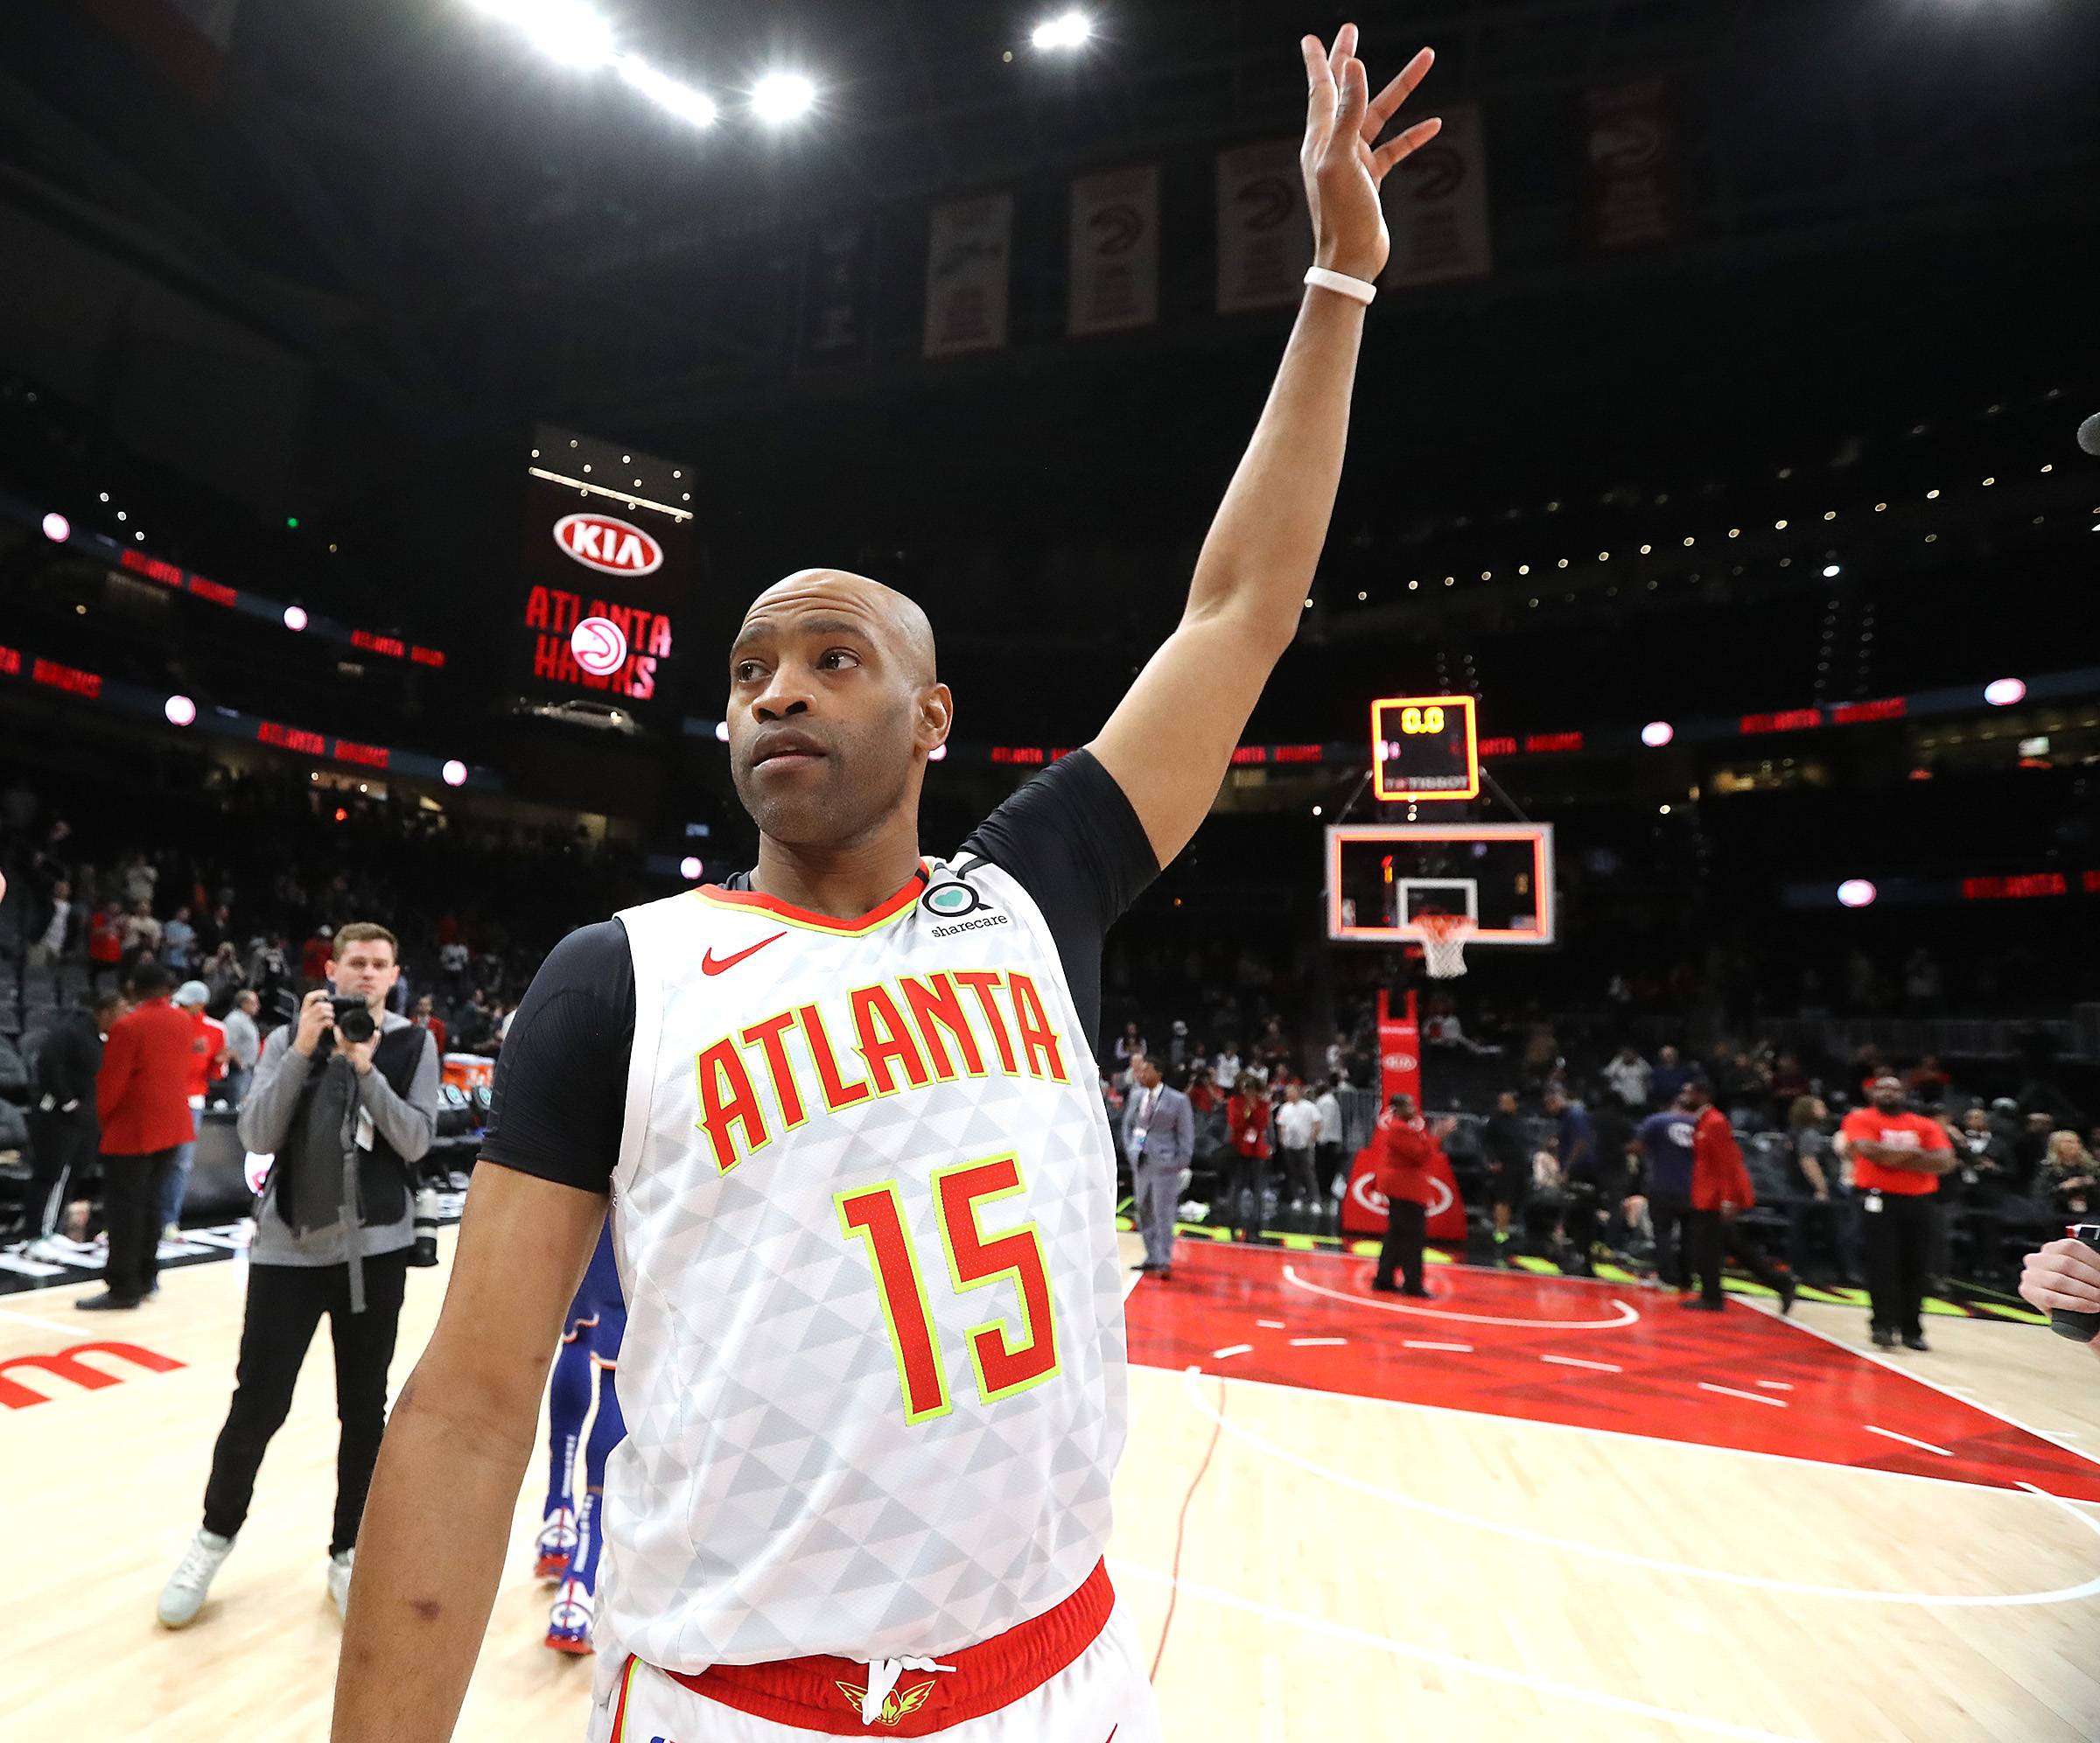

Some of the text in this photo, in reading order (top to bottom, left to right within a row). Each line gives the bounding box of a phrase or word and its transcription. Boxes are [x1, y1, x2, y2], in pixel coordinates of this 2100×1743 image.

[571, 521, 646, 569] KIA
[1401, 706, 1445, 734] 0.0
[931, 914, 1008, 939] sharecare
[696, 969, 1071, 1177] ATLANTA
[833, 1150, 1062, 1426] 15
